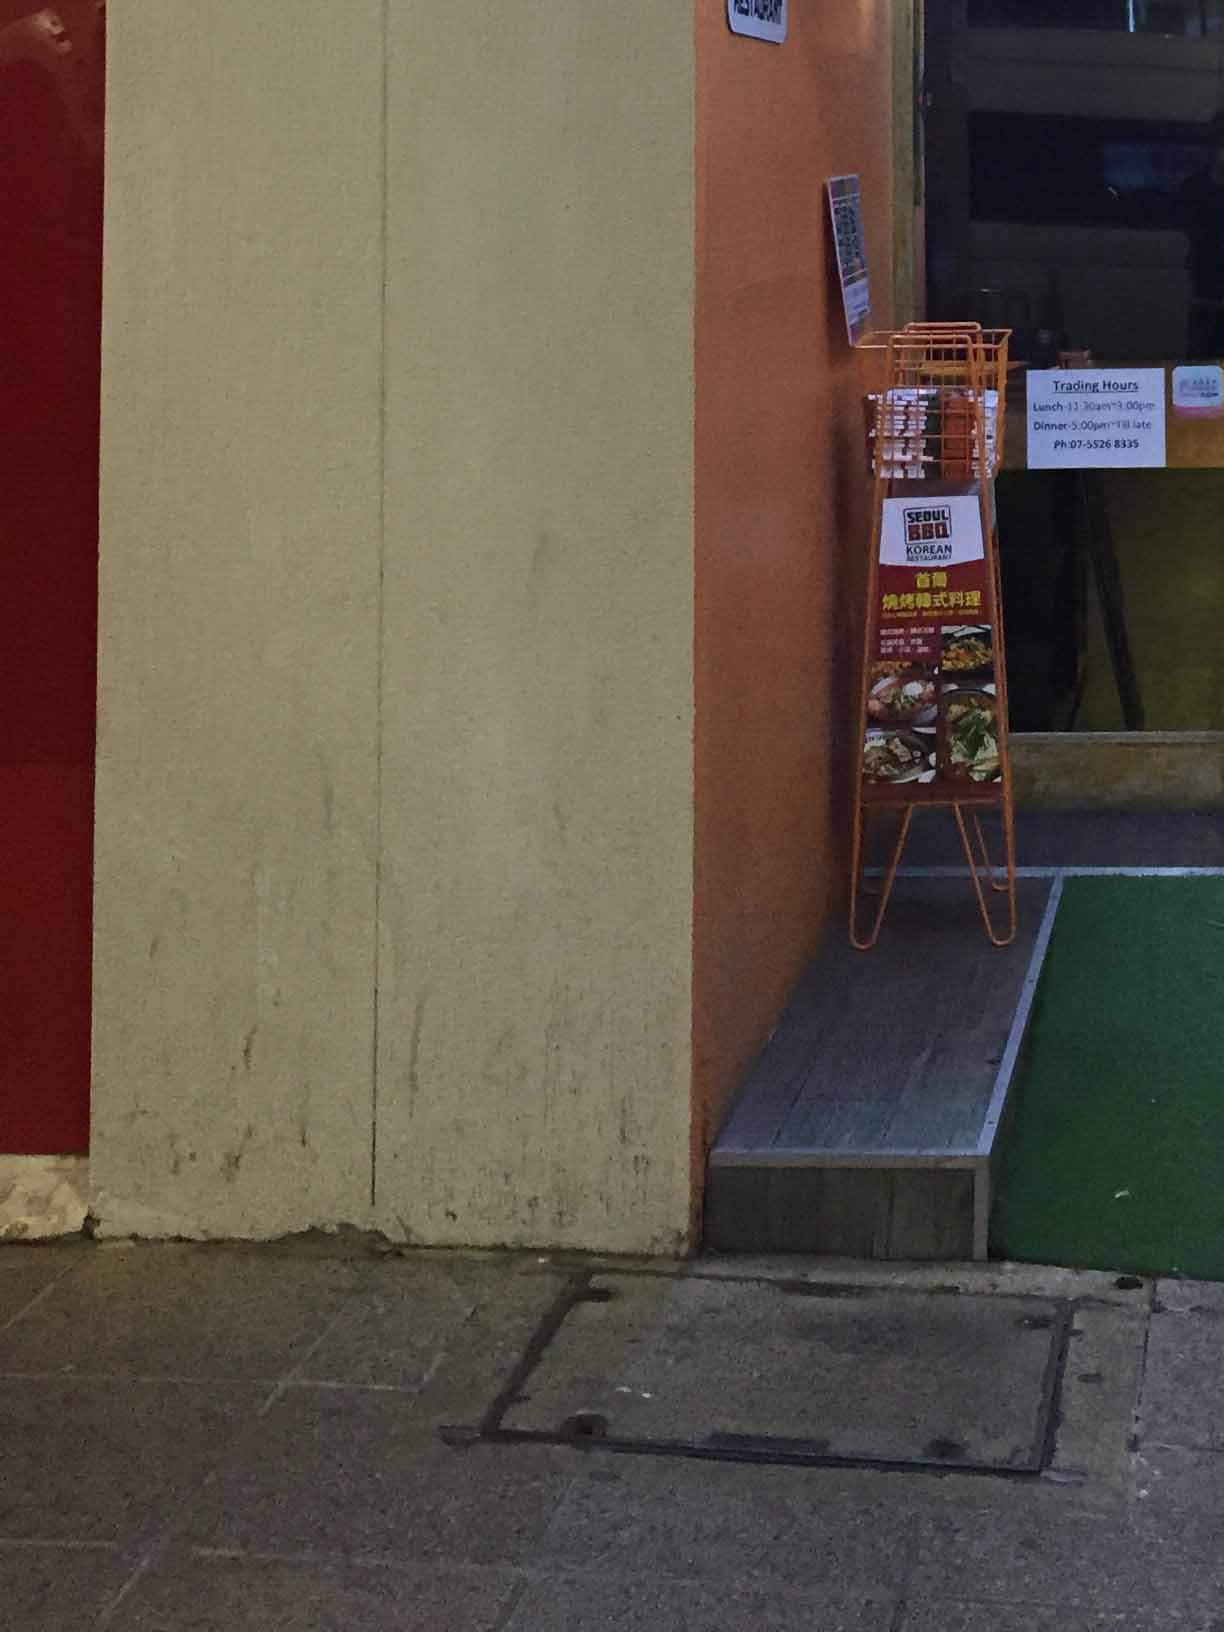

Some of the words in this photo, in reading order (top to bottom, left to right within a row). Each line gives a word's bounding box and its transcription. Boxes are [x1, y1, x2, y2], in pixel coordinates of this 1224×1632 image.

[1053, 380, 1099, 393] Trading
[1102, 380, 1139, 390] Hours
[1113, 439, 1139, 449] 8335
[907, 509, 949, 523] SEOUL
[908, 521, 950, 541] BBQ
[906, 544, 952, 554] KOREAN
